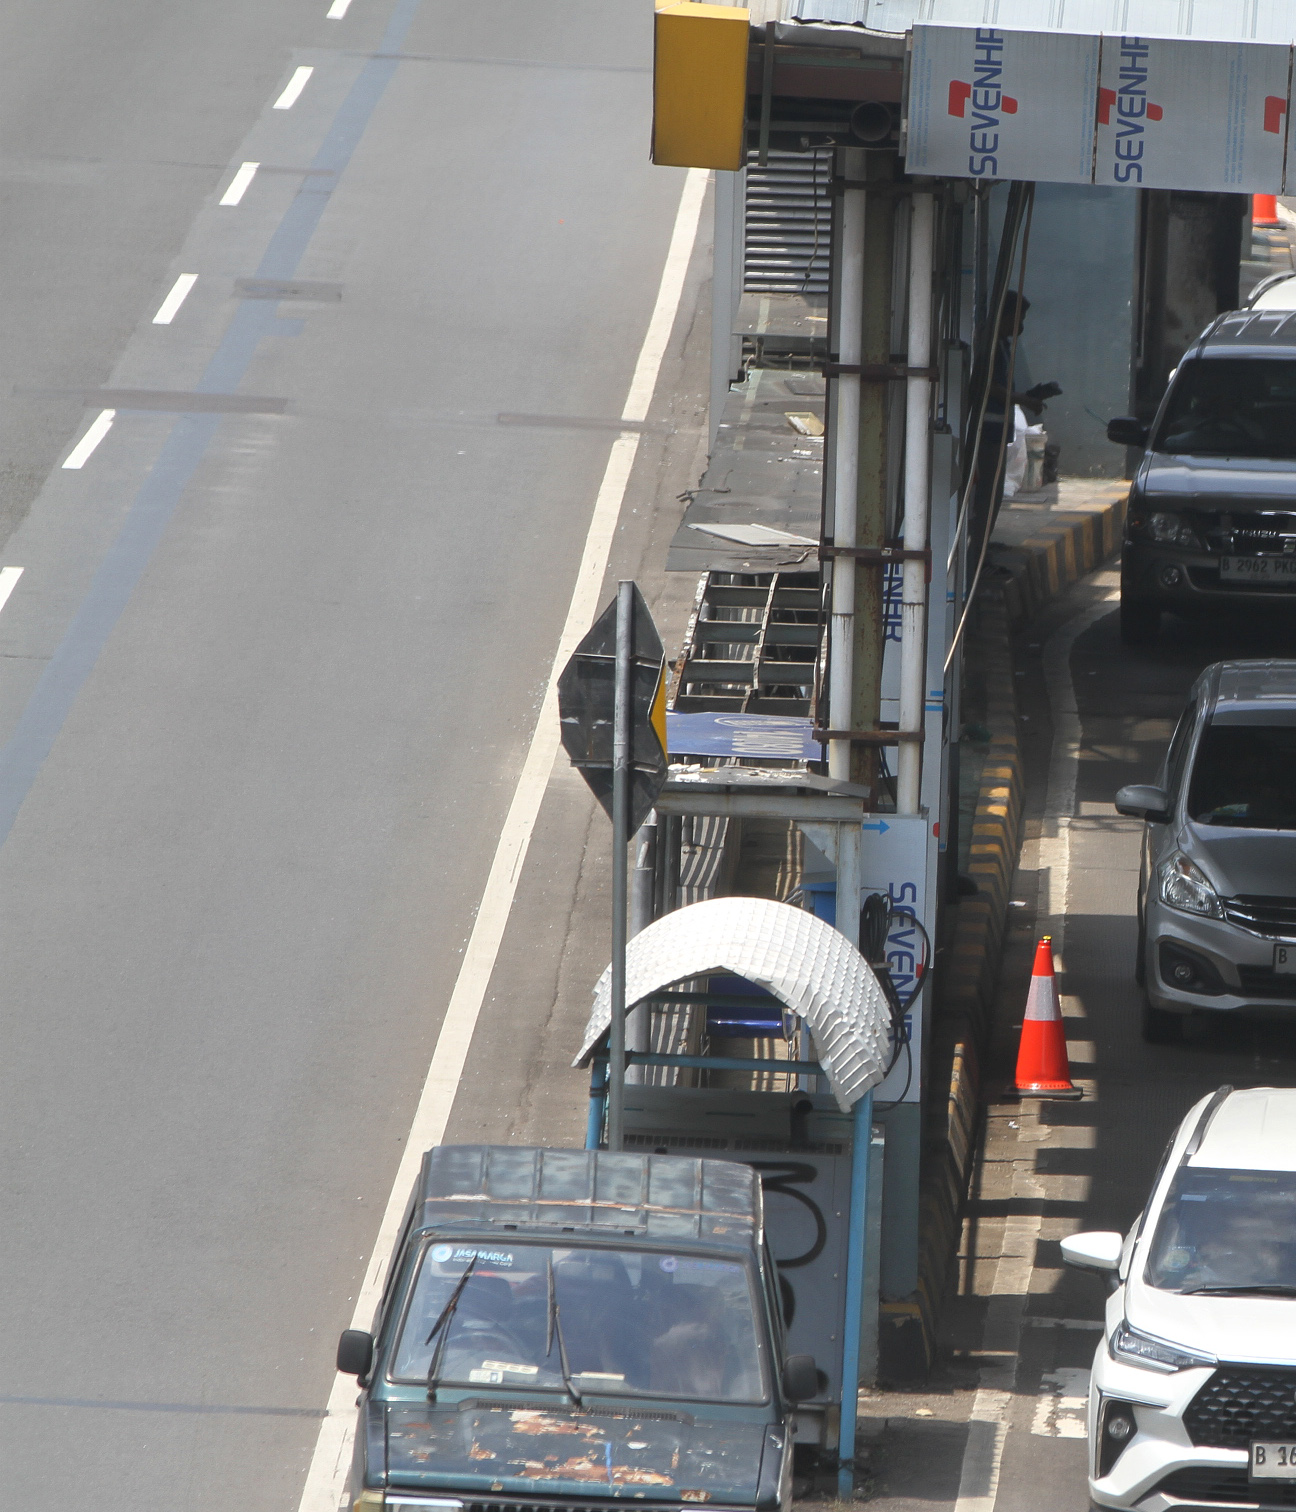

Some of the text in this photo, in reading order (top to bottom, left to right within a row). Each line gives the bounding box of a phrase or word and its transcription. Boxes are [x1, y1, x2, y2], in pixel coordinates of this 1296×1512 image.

[1222, 558, 1231, 571] B
[1278, 948, 1288, 964] B
[1255, 1445, 1266, 1465] B
